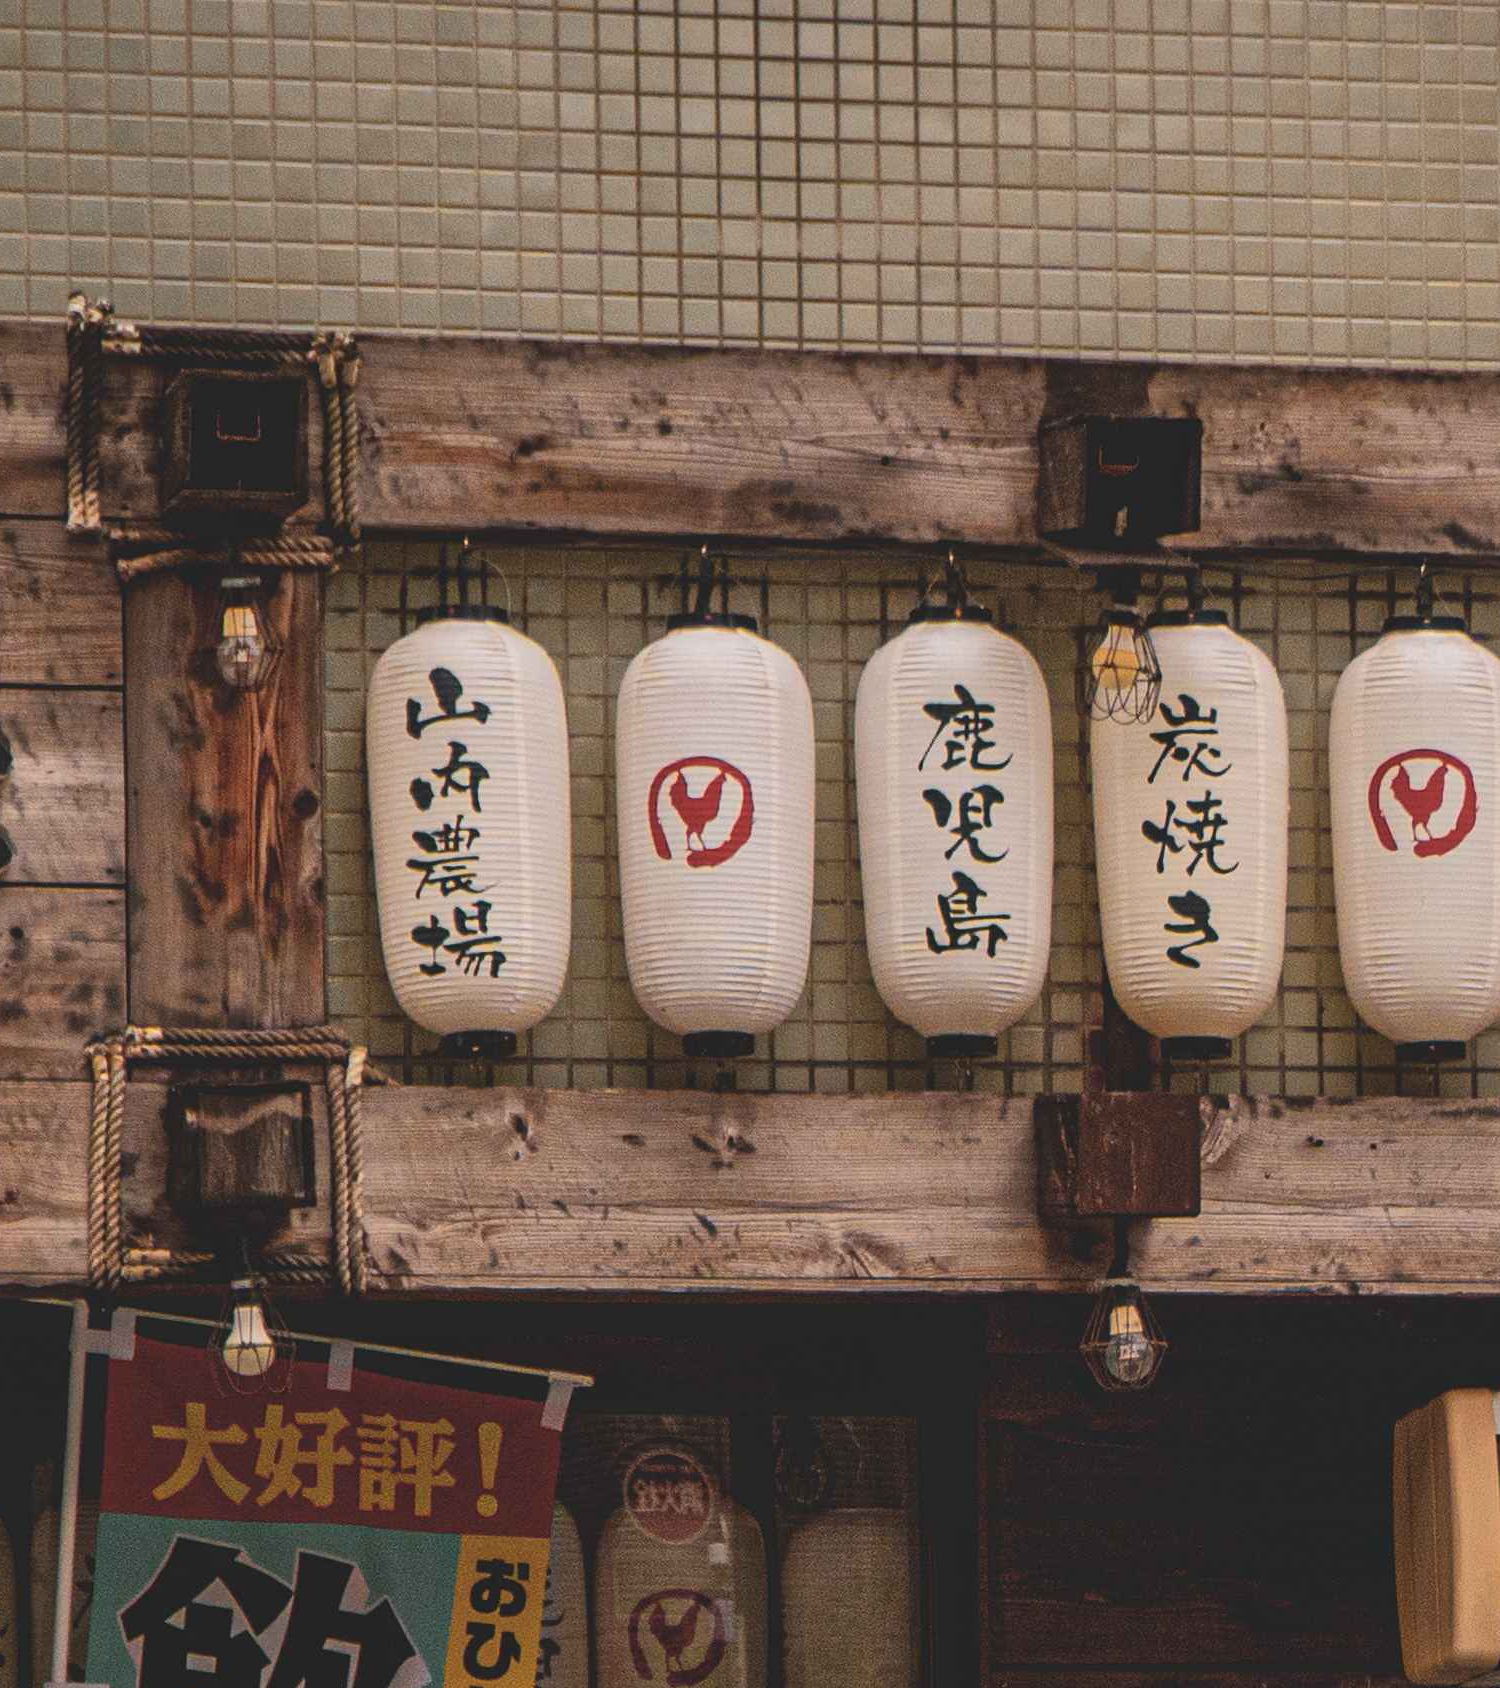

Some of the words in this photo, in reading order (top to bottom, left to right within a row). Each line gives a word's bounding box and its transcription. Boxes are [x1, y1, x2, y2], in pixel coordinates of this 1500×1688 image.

[405, 667, 506, 978] 山内農場
[917, 684, 1012, 959] 鹿児島
[1141, 693, 1240, 969] 炭焼き
[151, 1402, 503, 1518] 大好評！
